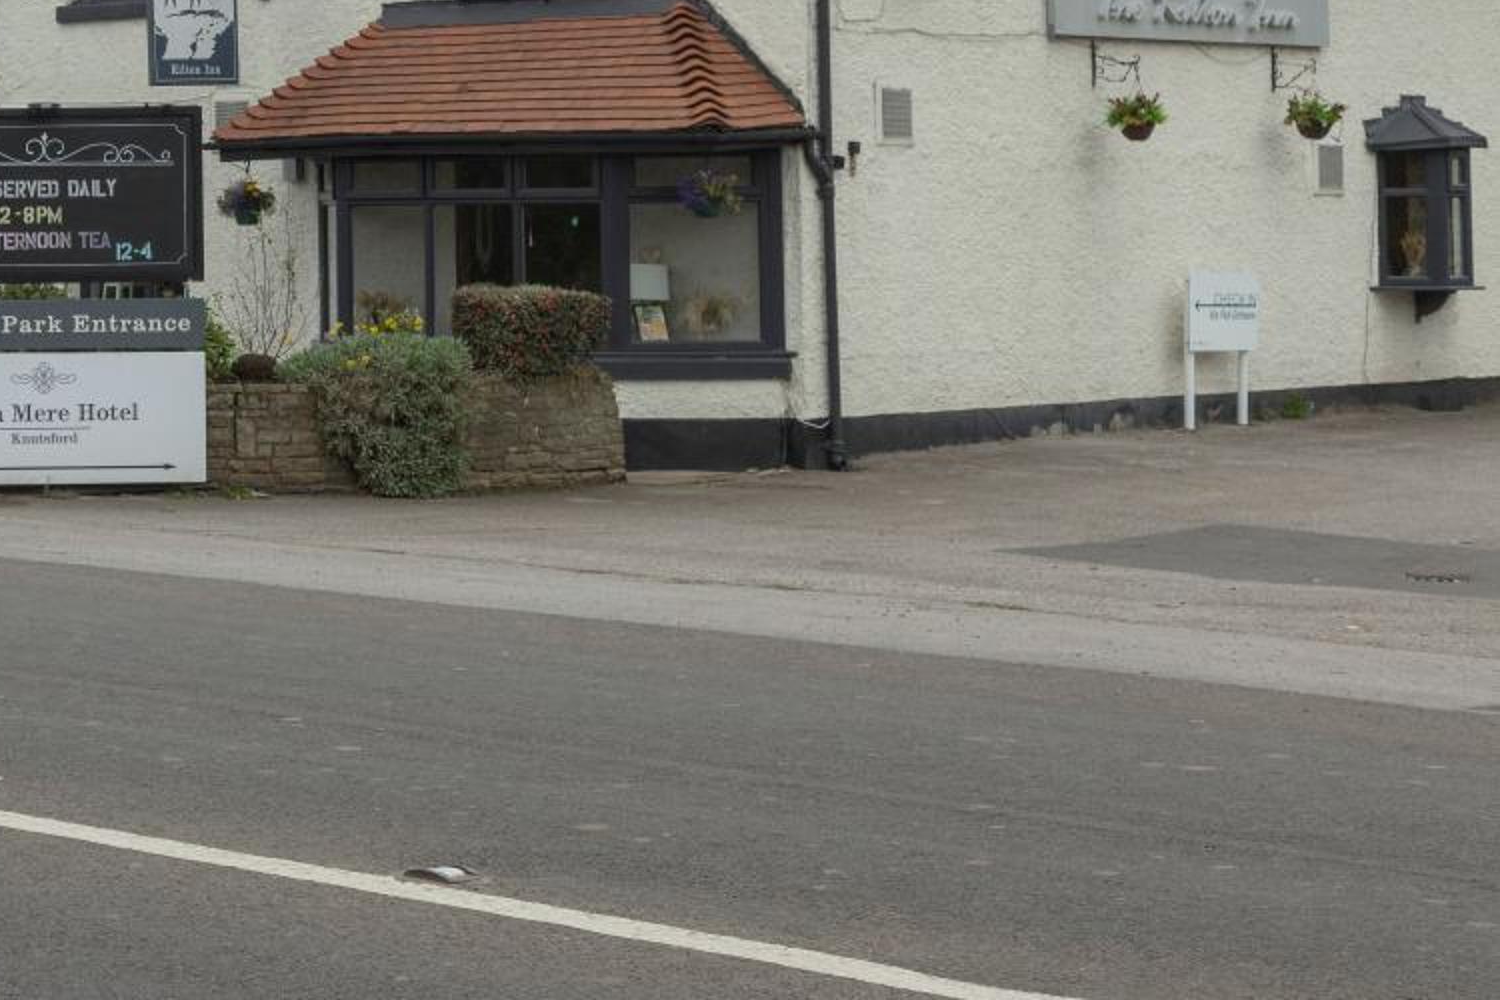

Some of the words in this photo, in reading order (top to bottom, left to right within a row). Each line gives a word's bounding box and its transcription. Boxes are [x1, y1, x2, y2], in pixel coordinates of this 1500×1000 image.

[67, 178, 117, 198] DAILY
[78, 231, 112, 250] TEA
[115, 240, 154, 262] 12-4
[1, 313, 65, 334] Park
[72, 313, 193, 333] Entrance
[11, 403, 71, 423] Mere
[78, 401, 141, 422] Hotel
[10, 431, 79, 446] Knutsford
